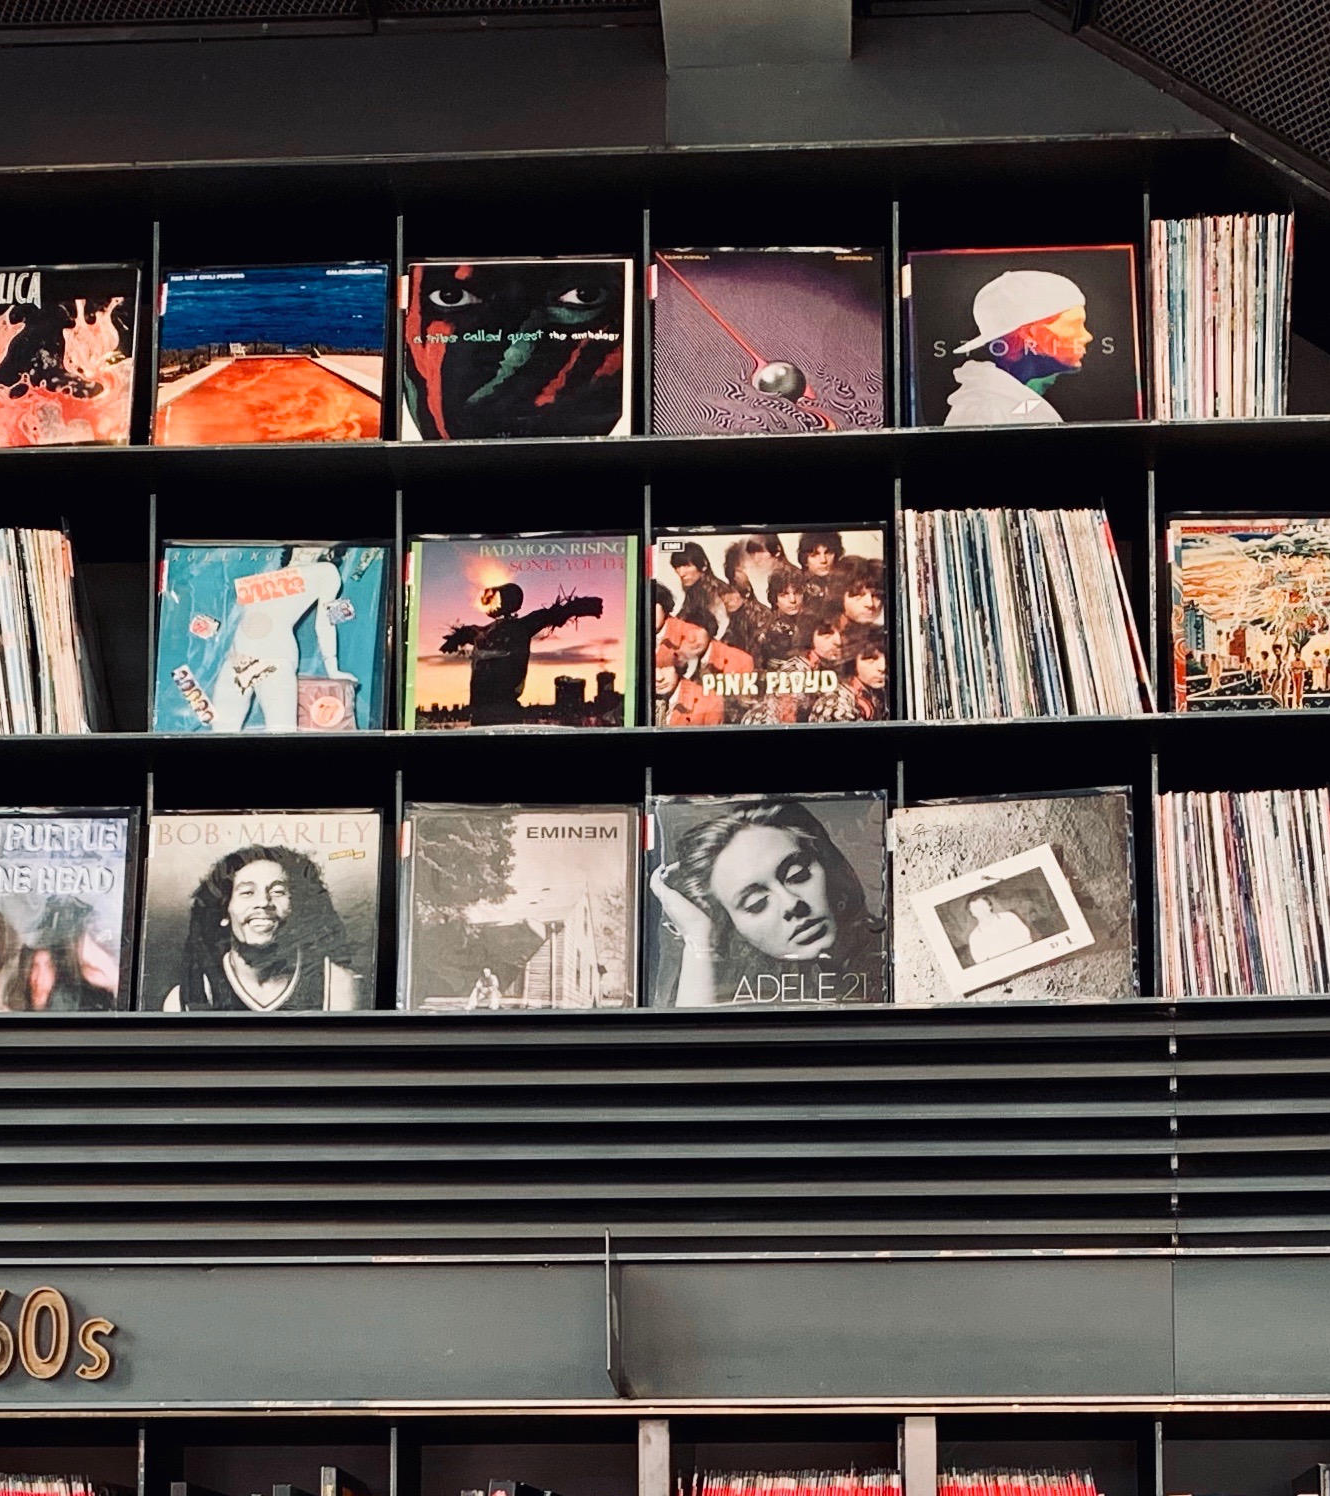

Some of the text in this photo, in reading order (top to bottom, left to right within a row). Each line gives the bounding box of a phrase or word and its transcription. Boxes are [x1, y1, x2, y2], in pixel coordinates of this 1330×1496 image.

[463, 329, 502, 343] called
[507, 329, 544, 345] quest
[548, 331, 566, 341] the
[571, 330, 620, 343] anthology
[479, 541, 626, 558] BAD MOON RISING
[158, 821, 371, 846] BOB MARLEY
[526, 826, 618, 839] EMINEM
[37, 866, 115, 894] HEAD
[732, 972, 868, 1004] ADELE 21
